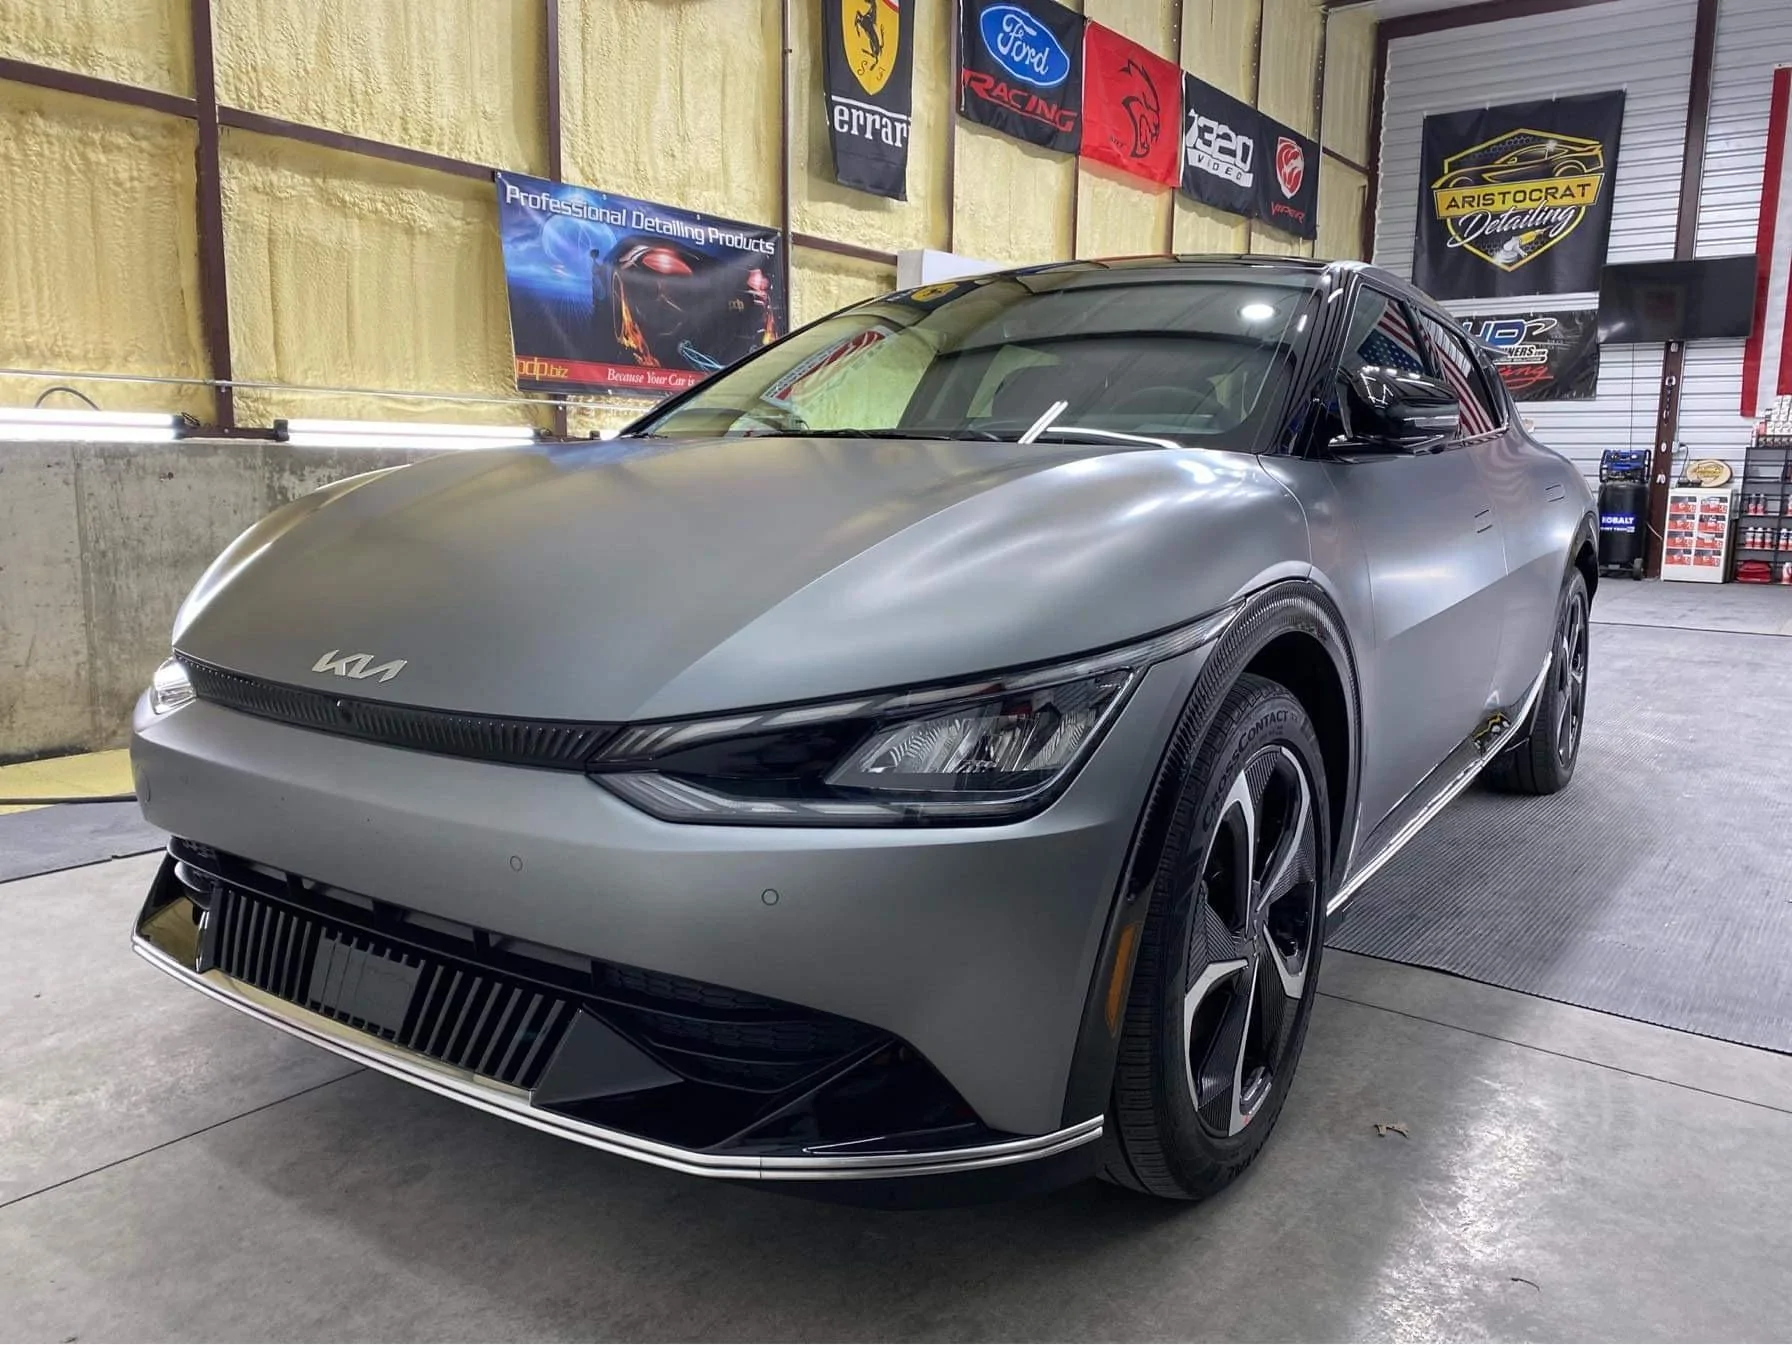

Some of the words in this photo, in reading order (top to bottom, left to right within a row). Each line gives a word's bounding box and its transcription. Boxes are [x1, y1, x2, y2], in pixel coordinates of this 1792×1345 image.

[997, 14, 1049, 76] Ford
[963, 68, 1078, 133] RACING
[833, 104, 910, 148] errar
[1197, 154, 1244, 182] VIDEO
[1445, 182, 1592, 211] ARISTOCRAT
[505, 184, 626, 228] Professional
[631, 210, 706, 246] Detailing
[708, 226, 775, 256] Products
[1447, 199, 1577, 248] Detailing
[607, 368, 645, 384] Because
[646, 371, 669, 385] Your
[668, 372, 687, 386] Car
[311, 649, 408, 683] KIA
